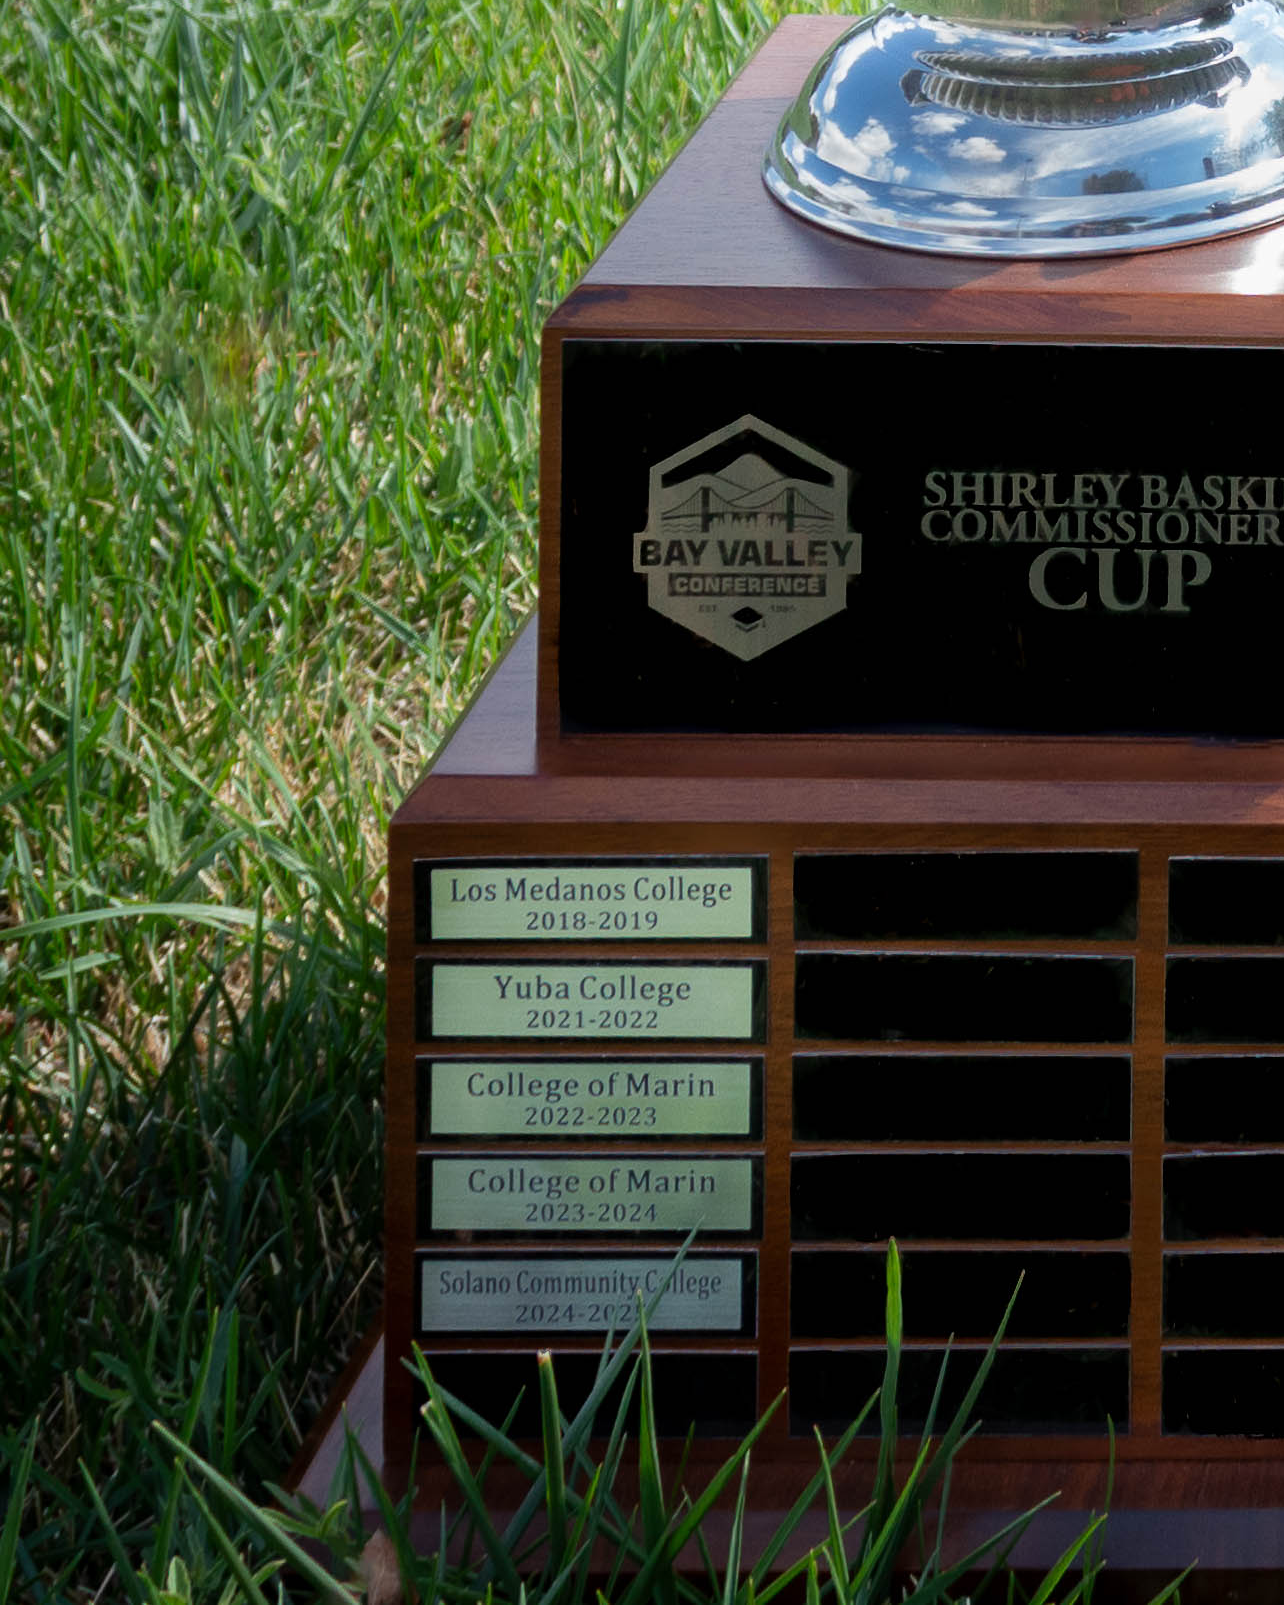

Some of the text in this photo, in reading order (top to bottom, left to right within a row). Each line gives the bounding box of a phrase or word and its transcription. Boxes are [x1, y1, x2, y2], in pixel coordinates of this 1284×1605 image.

[922, 470, 1131, 508] SHIRLEY
[640, 539, 853, 567] BAY VALLEY
[674, 576, 821, 594] CONFERENCE
[1028, 546, 1212, 612] CUP
[451, 876, 732, 908] Los Medanos College
[526, 911, 659, 931] 2018-2019
[494, 974, 691, 1007] Yuba College
[526, 1010, 659, 1030] 2021-2022
[467, 1071, 716, 1103] College of Marin
[525, 1106, 657, 1126] 2022-2023
[468, 1168, 716, 1200] College of Marin
[525, 1202, 658, 1222] 2023-2024
[440, 1269, 511, 1295] Solano
[516, 1270, 640, 1300] Community
